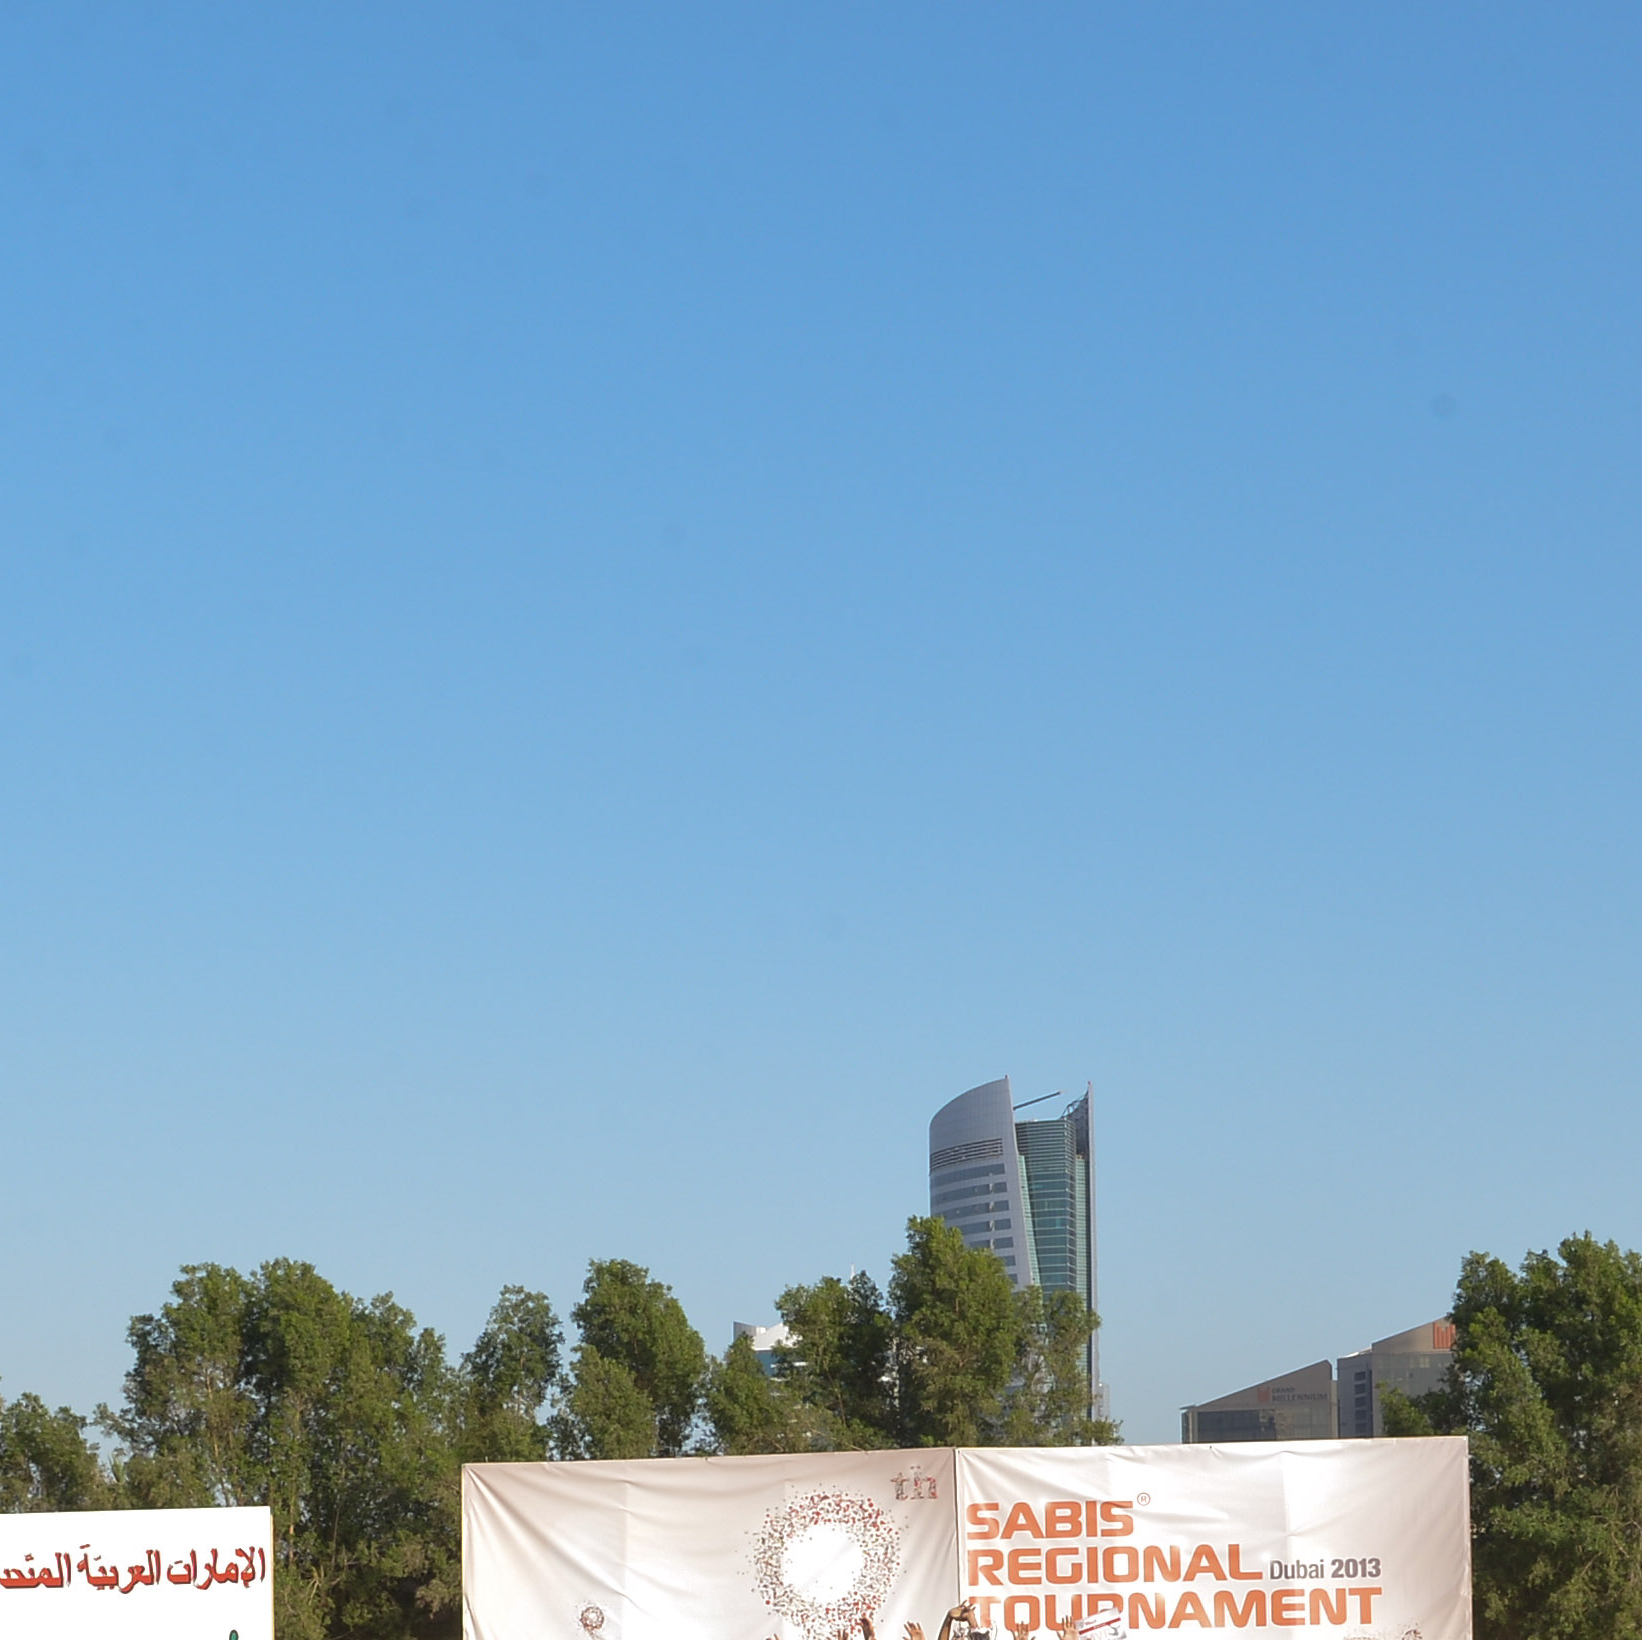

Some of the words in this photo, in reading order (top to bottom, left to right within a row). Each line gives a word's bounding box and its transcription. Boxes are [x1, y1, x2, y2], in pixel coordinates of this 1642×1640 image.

[968, 1544, 1263, 1586] REGIONAL
[1270, 1559, 1324, 1580] Dubai
[1331, 1558, 1381, 1579] 2013
[968, 1587, 1382, 1635] TOURNAMENT
